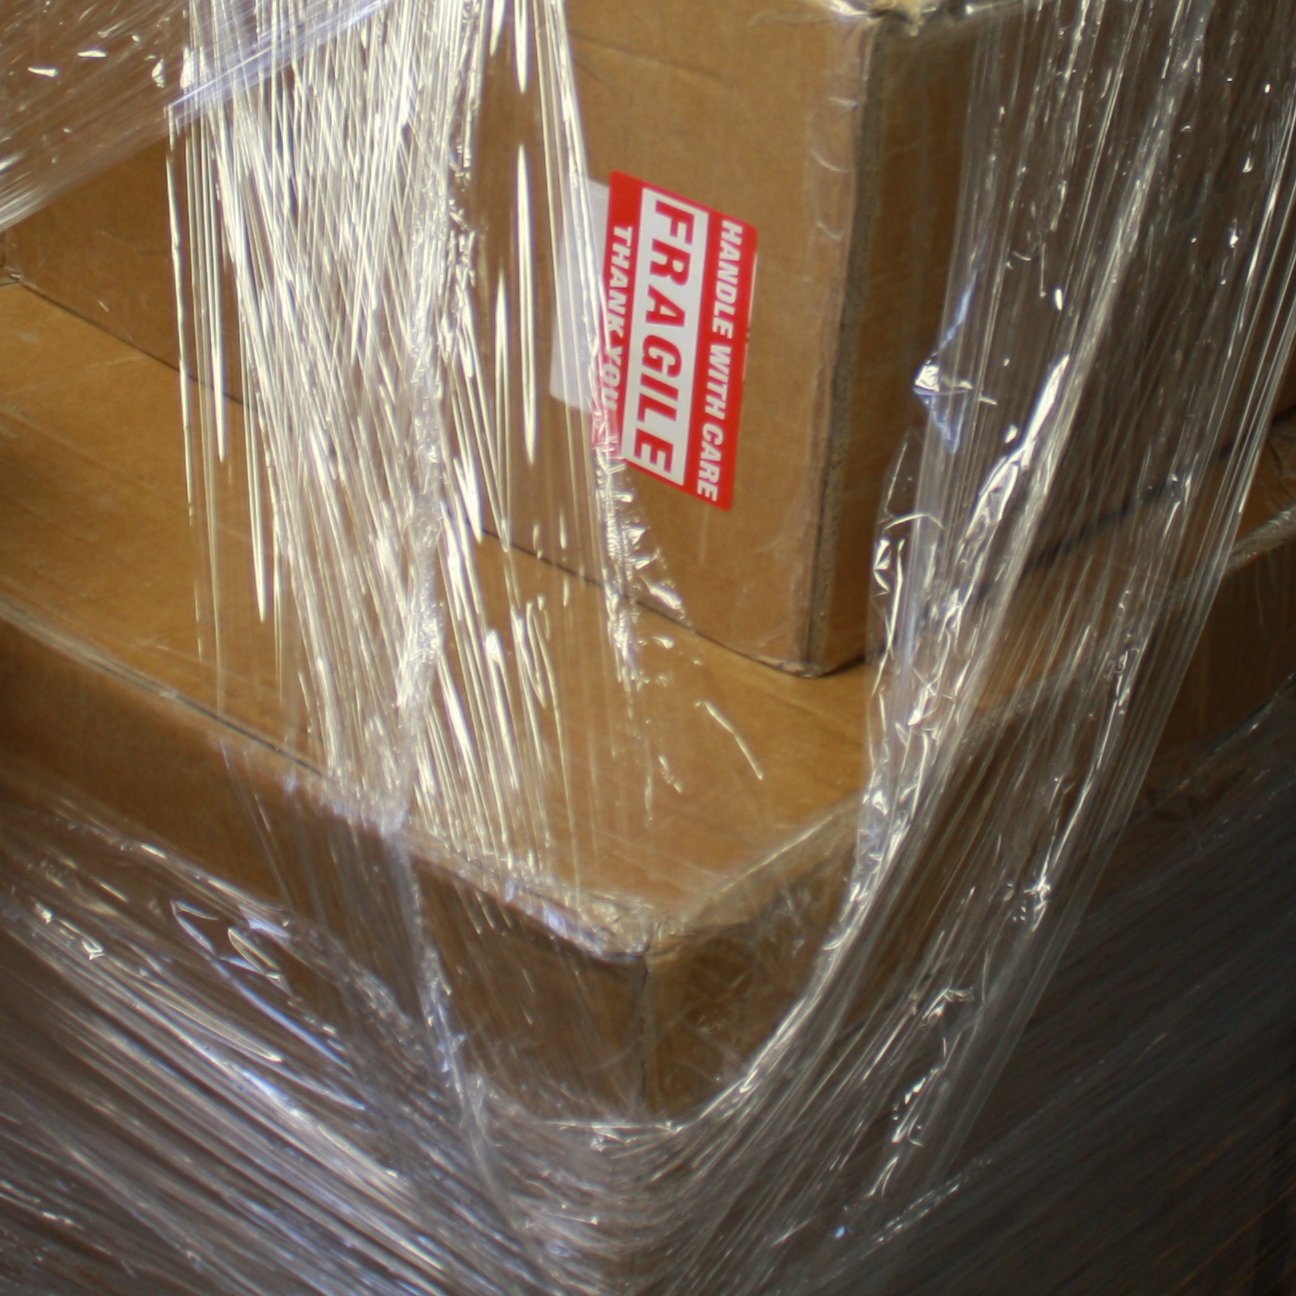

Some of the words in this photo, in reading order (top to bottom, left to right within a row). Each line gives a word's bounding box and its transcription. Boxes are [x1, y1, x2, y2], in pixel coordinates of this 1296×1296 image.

[605, 226, 633, 346] THANK
[712, 219, 743, 339] HANDLE
[601, 344, 625, 410] YOU
[633, 200, 696, 475] FRAGILE
[704, 342, 732, 420] WITH
[696, 419, 724, 502] CARE
